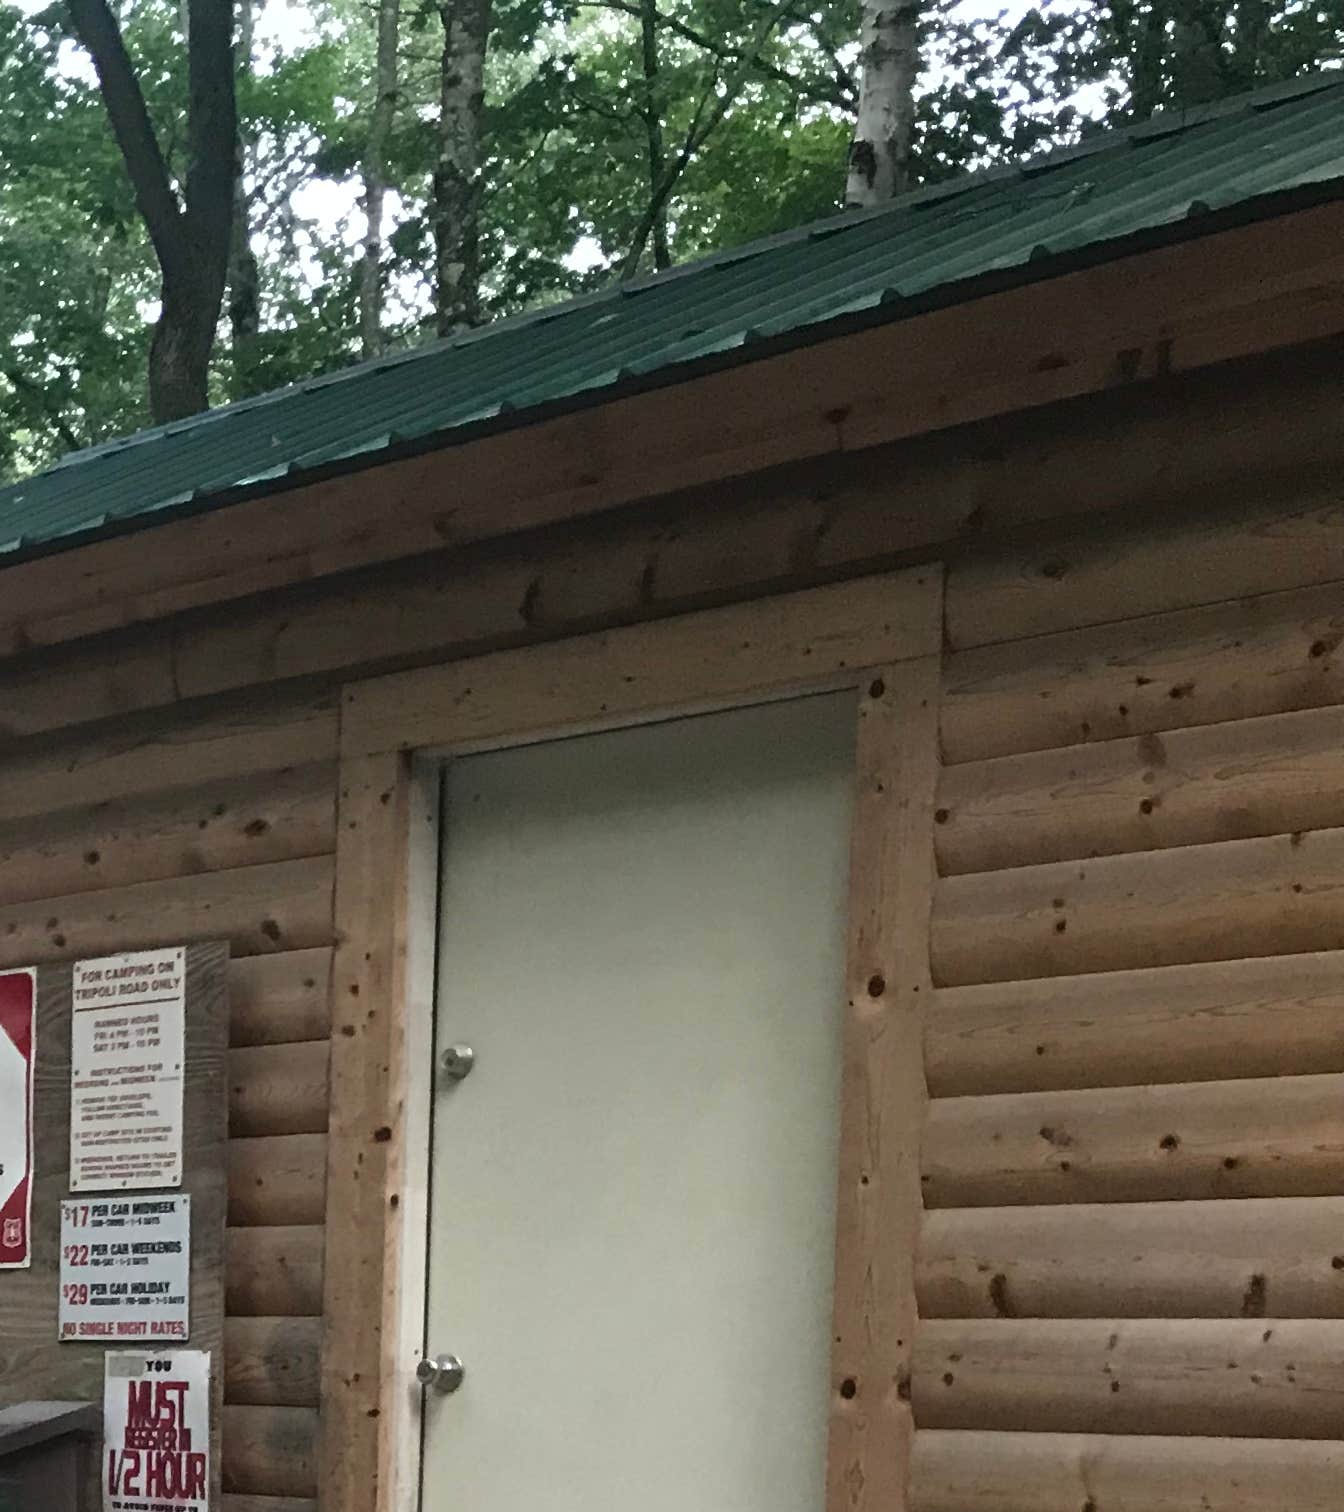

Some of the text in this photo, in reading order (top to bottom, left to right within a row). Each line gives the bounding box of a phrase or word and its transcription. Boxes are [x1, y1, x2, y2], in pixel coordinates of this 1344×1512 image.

[81, 961, 175, 983] FOR CAMPING ON
[75, 977, 181, 1000] TRIPOLI ROAD ONLY
[64, 1201, 175, 1227] $17 PER CAR MIDWEEK
[64, 1241, 181, 1266] $22 PER CAR WEEKENDS
[63, 1282, 170, 1305] $29 PER CAR HOLIDAY
[63, 1321, 184, 1335] NO SINGLE NIGHT RATES
[145, 1361, 172, 1372] YOU
[128, 1380, 190, 1430] MUST
[108, 1449, 206, 1501] 1/2 HOUR
[123, 1502, 149, 1511] AVOID
